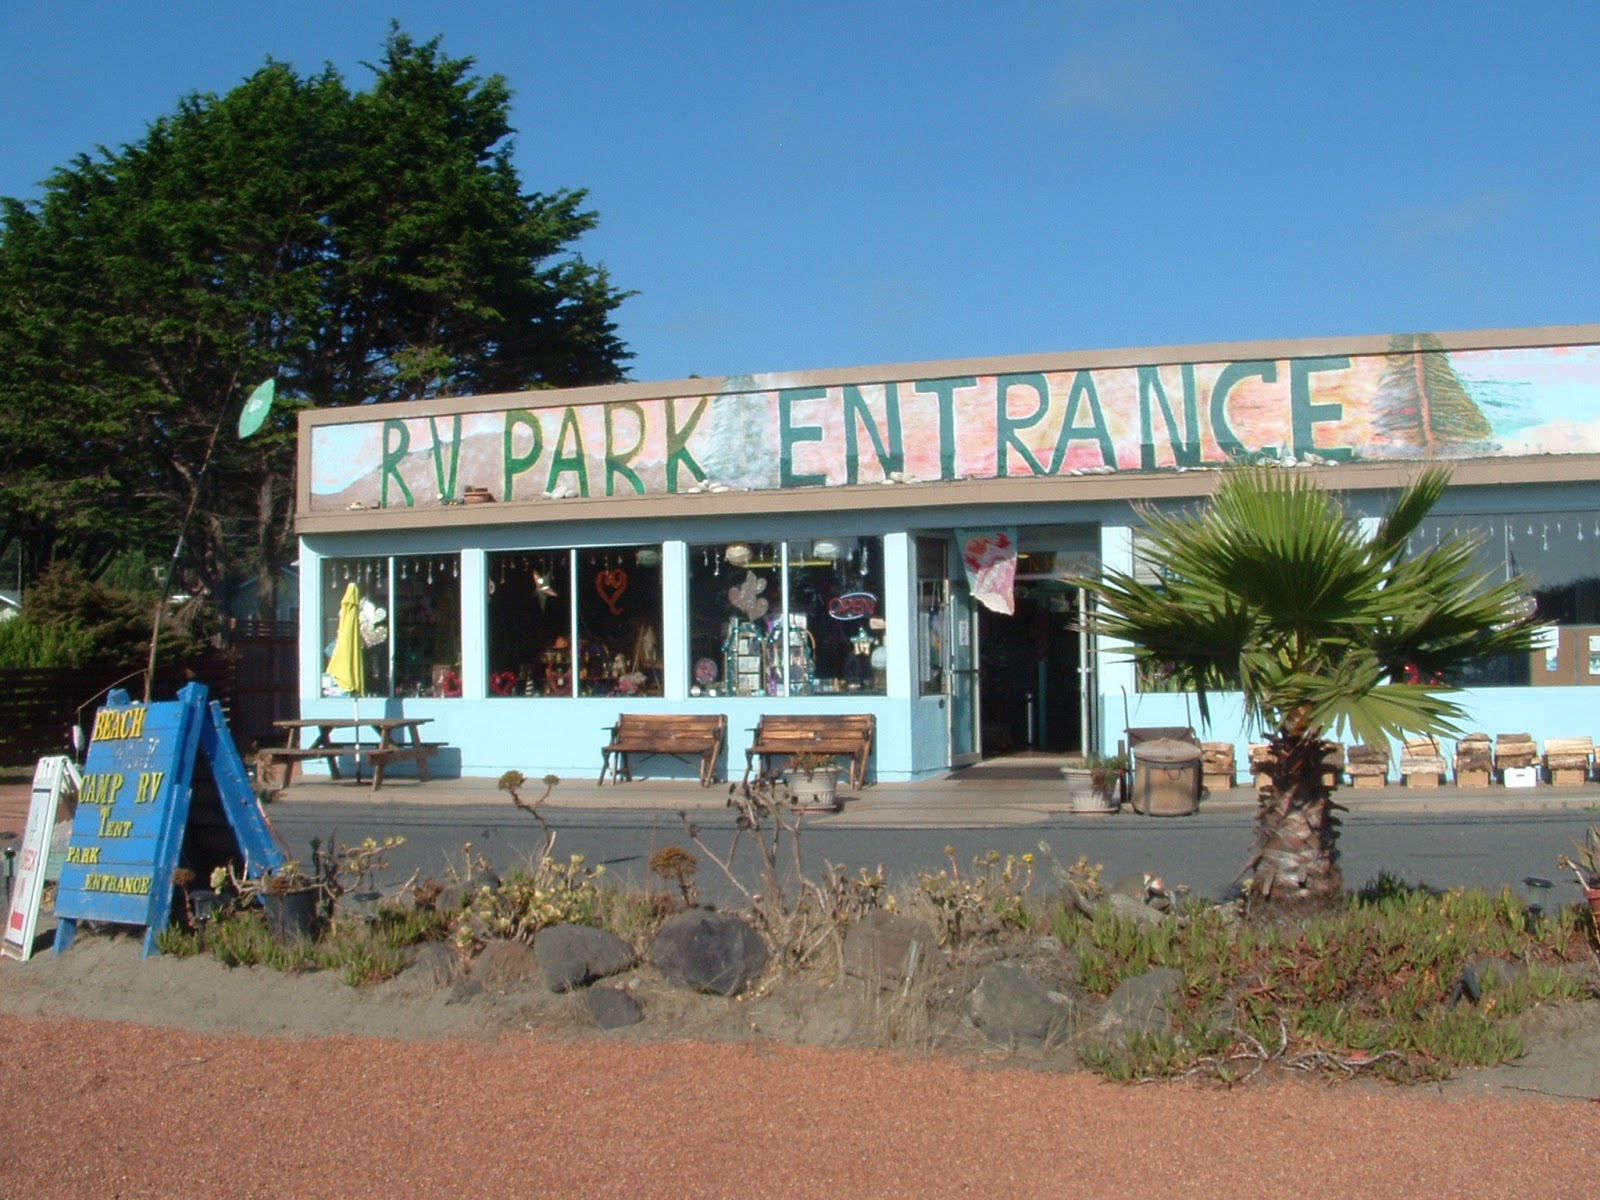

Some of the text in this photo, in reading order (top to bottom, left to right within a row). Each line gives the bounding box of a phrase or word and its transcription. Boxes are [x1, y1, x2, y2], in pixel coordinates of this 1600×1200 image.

[378, 357, 1355, 508] RV PARK ENTRANCE
[828, 597, 876, 615] OPEN
[93, 709, 146, 741] BEACH
[79, 773, 163, 804] CAMP RV
[68, 848, 100, 863] PARK
[85, 875, 151, 895] ENTRANCE
